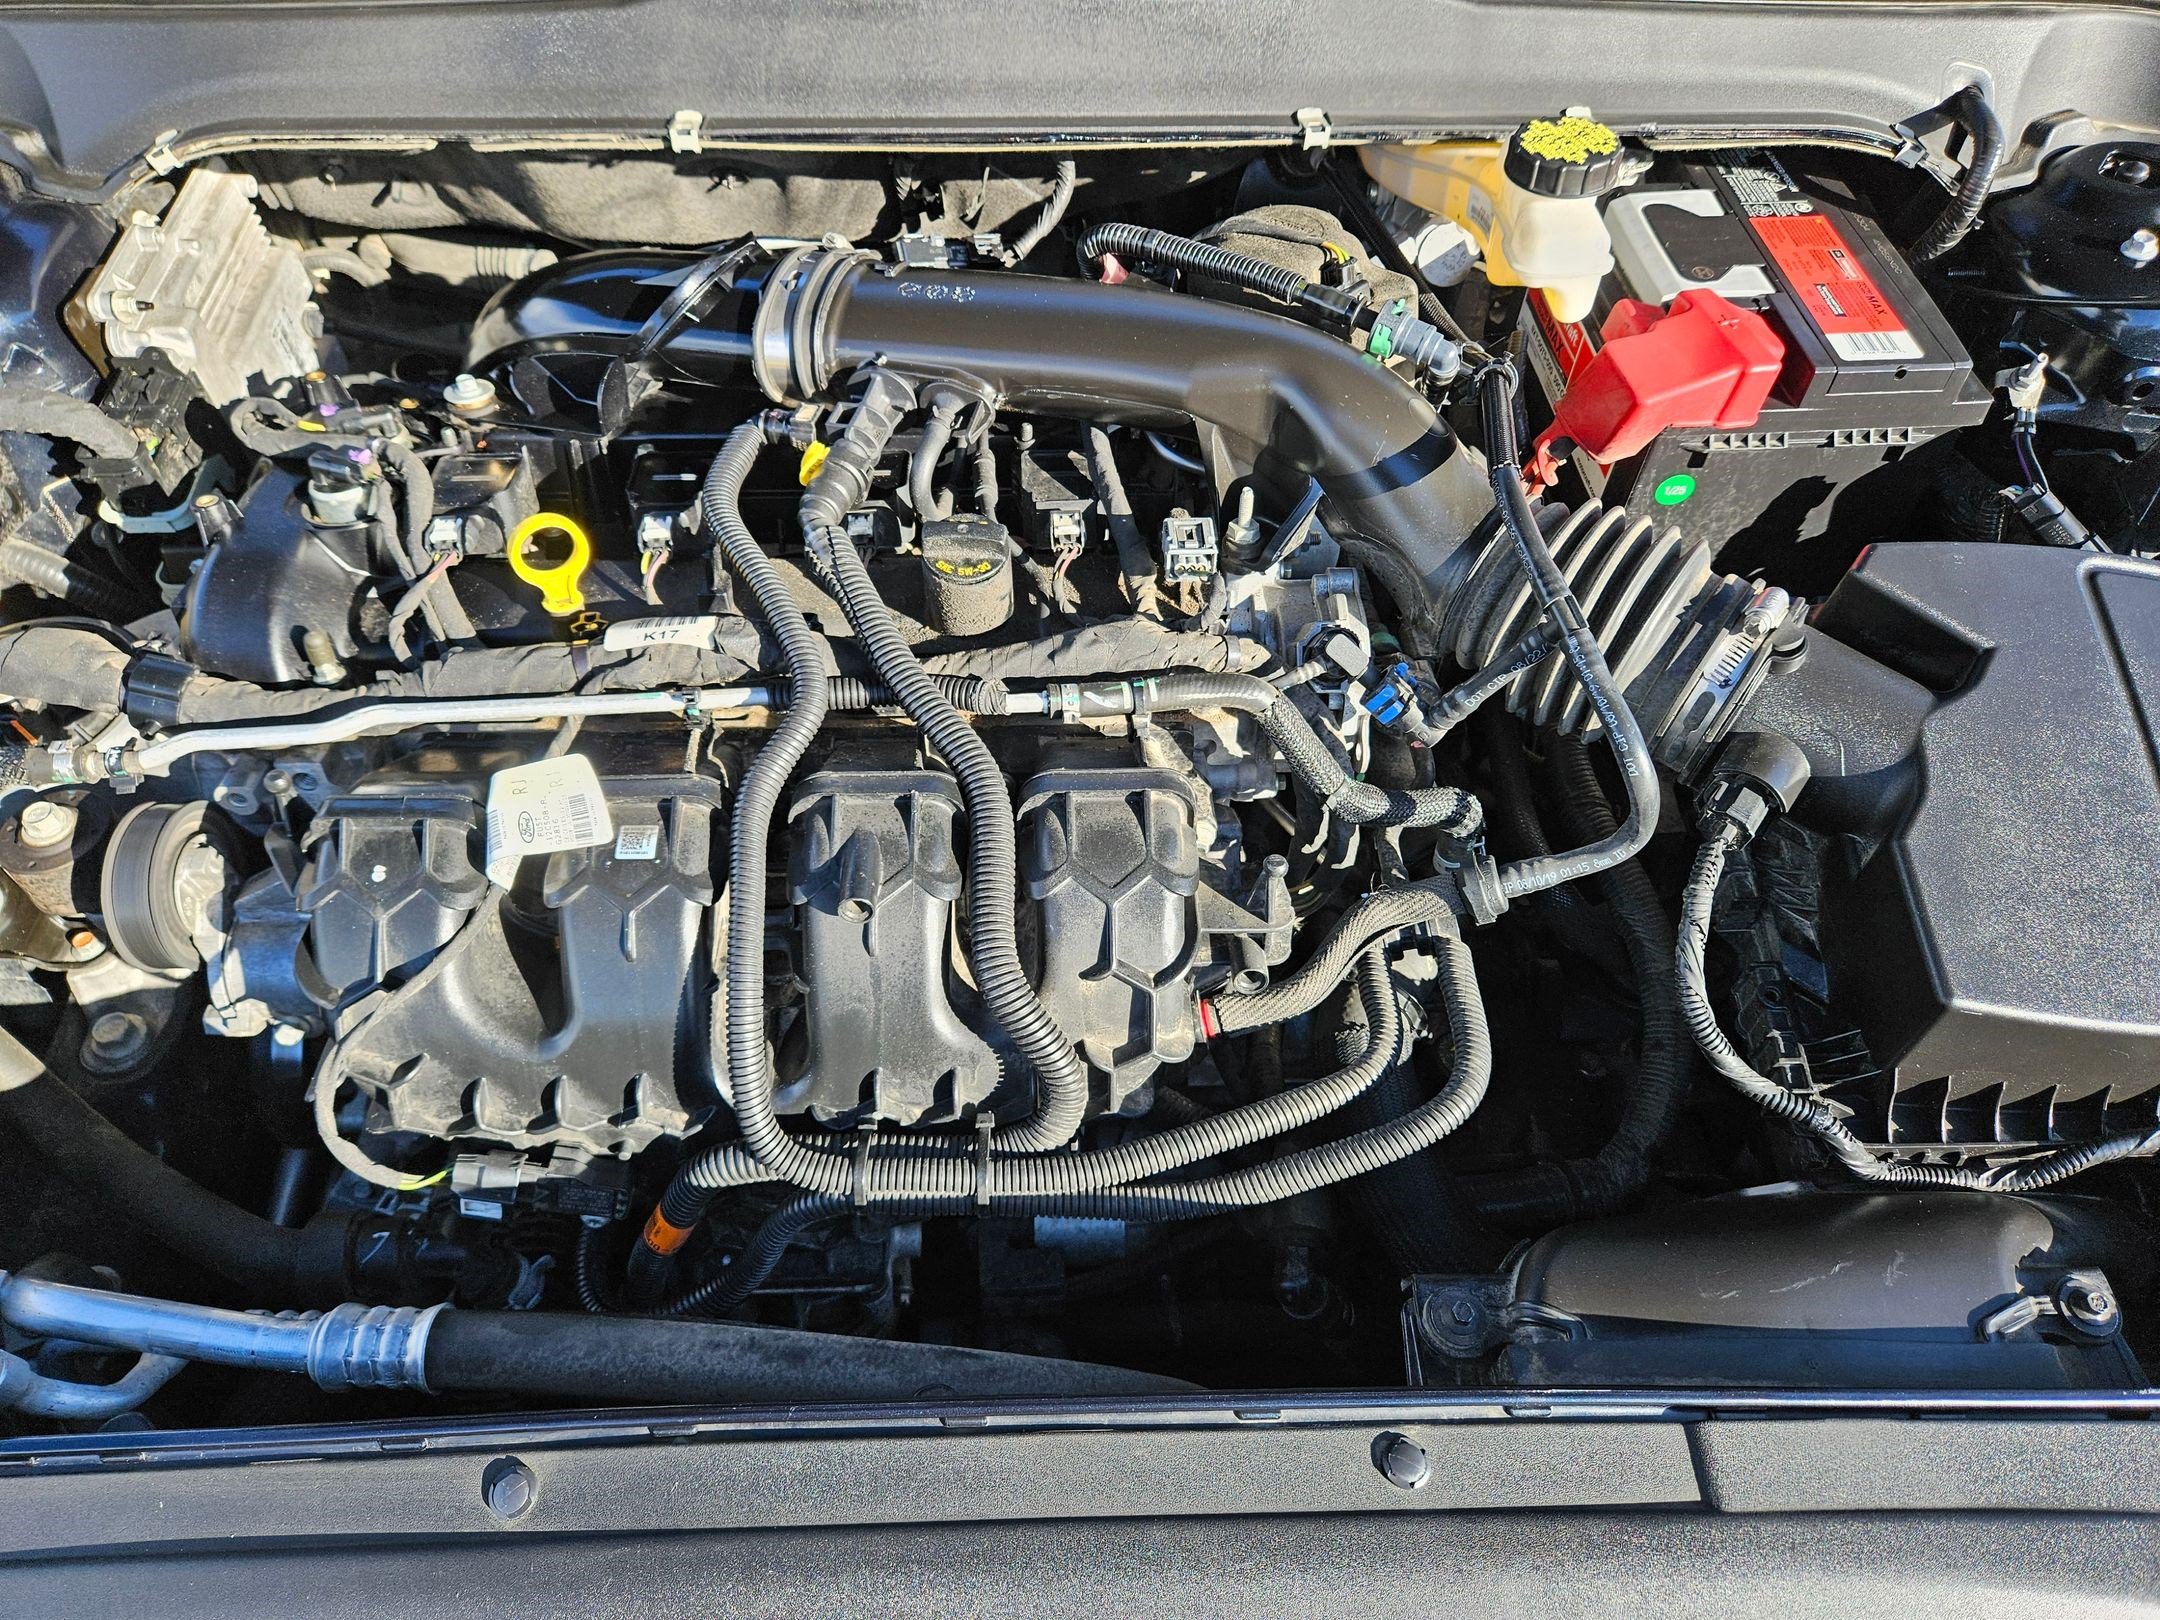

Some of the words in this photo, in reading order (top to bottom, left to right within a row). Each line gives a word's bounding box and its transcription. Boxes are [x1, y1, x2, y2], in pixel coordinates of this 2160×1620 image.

[935, 560, 955, 574] SAE
[643, 629, 680, 641] K17
[1464, 690, 1486, 707] DOT
[1487, 673, 1507, 690] CIP
[1510, 643, 1548, 673] 08/22/
[1573, 654, 1594, 682] 01:15
[1612, 730, 1629, 752] CIP
[1623, 757, 1640, 777] DOT
[511, 779, 528, 795] RJ
[1502, 881, 1514, 894] IP
[1560, 861, 1590, 878] 01:15
[1593, 857, 1613, 869] 8mm
